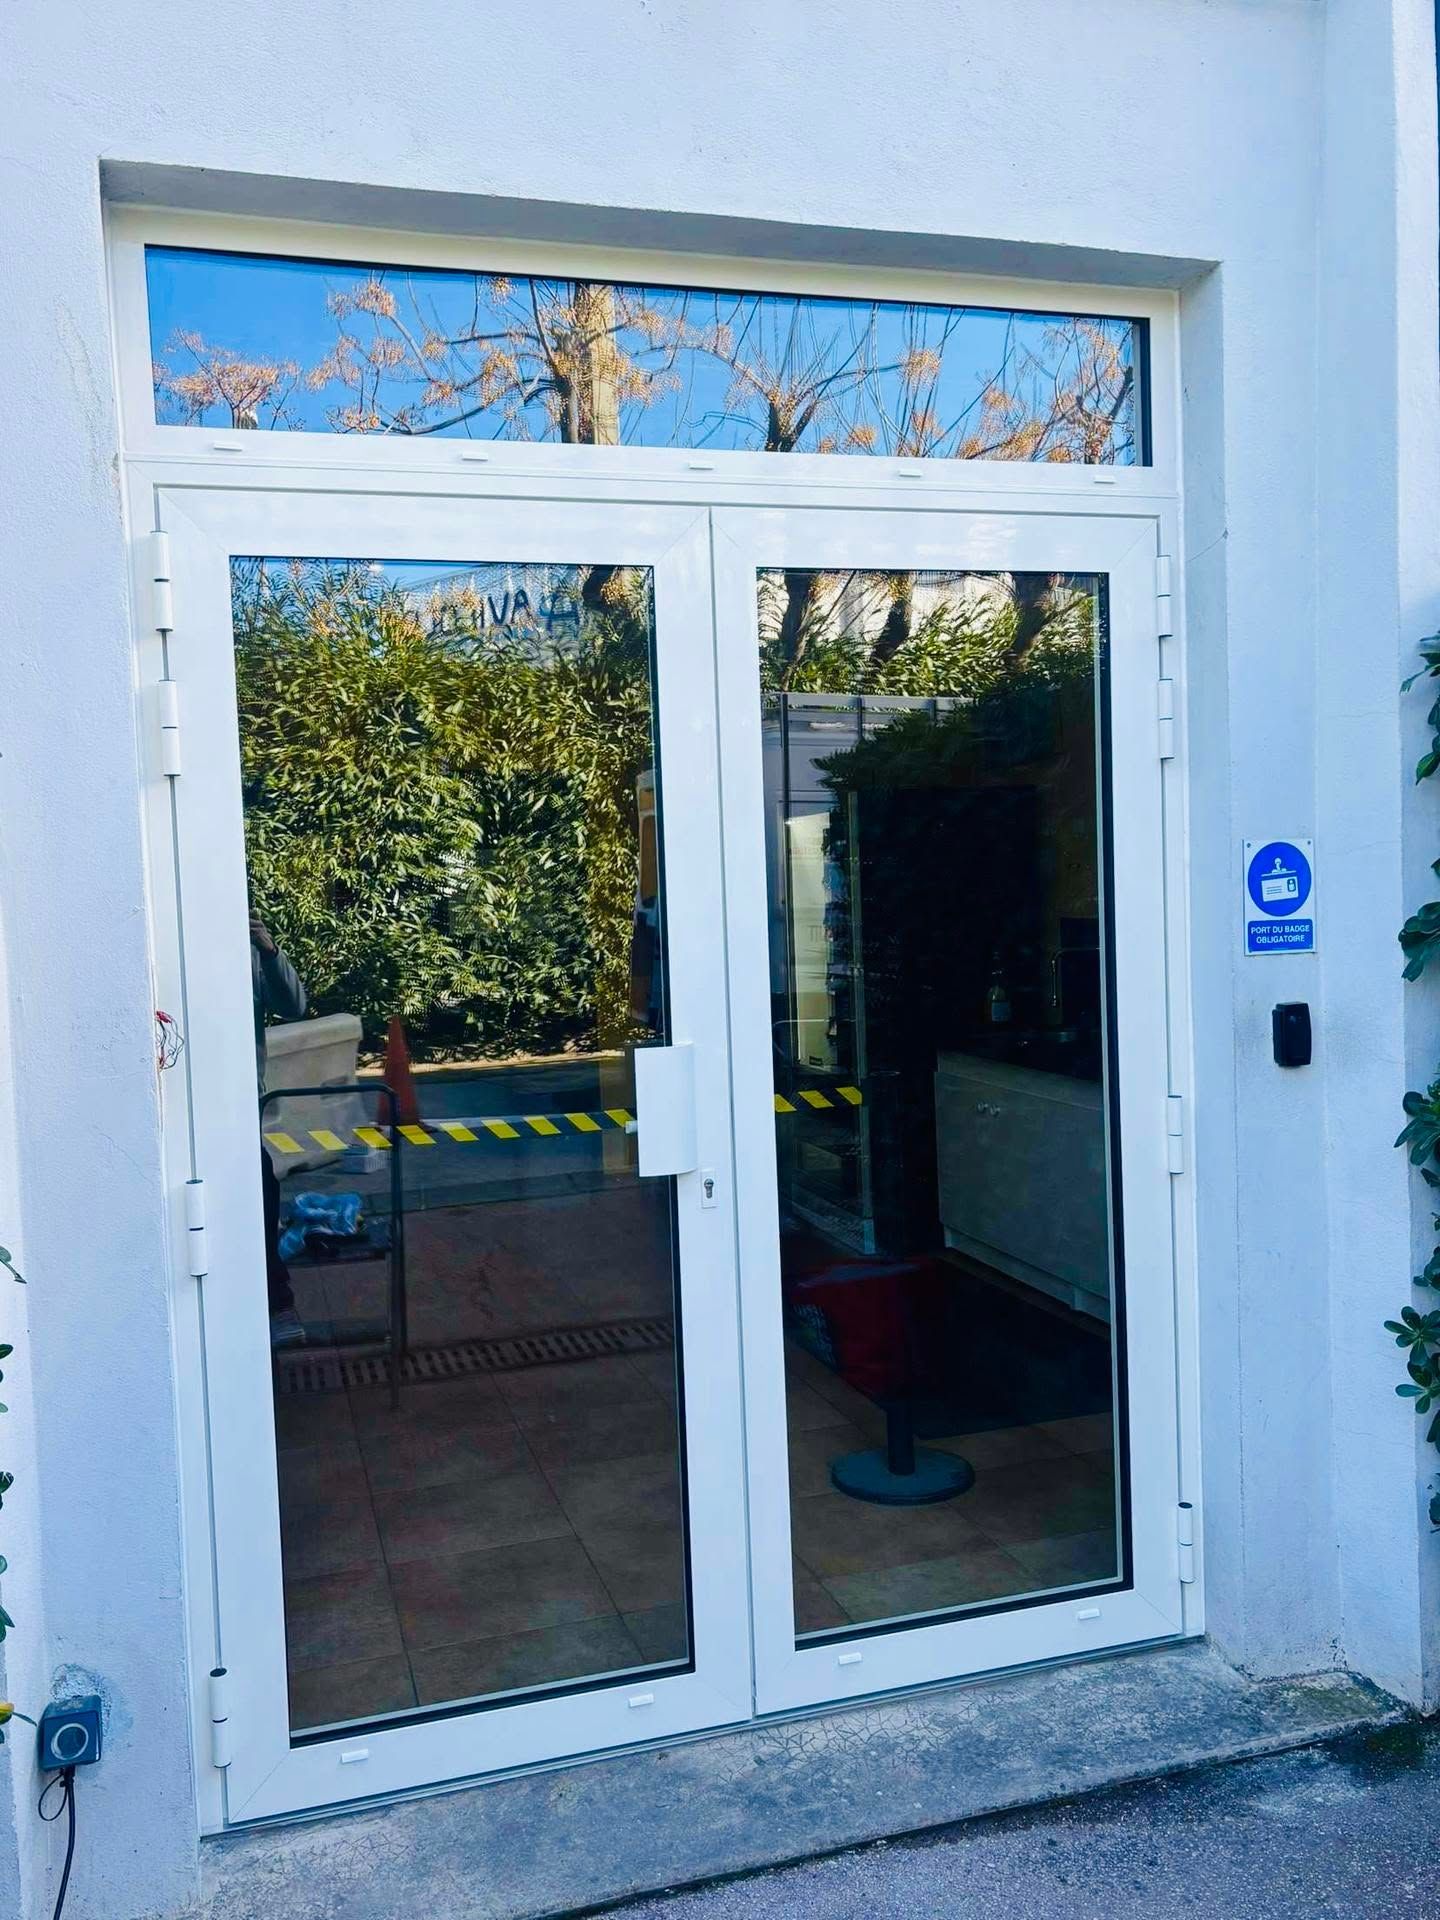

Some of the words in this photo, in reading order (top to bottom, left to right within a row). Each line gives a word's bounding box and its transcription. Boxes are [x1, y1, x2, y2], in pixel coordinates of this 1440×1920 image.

[1251, 926, 1271, 935] PORT
[1272, 926, 1283, 934] DU
[1284, 925, 1310, 933] BADGE
[1256, 935, 1305, 944] OBLIGATOIRE
